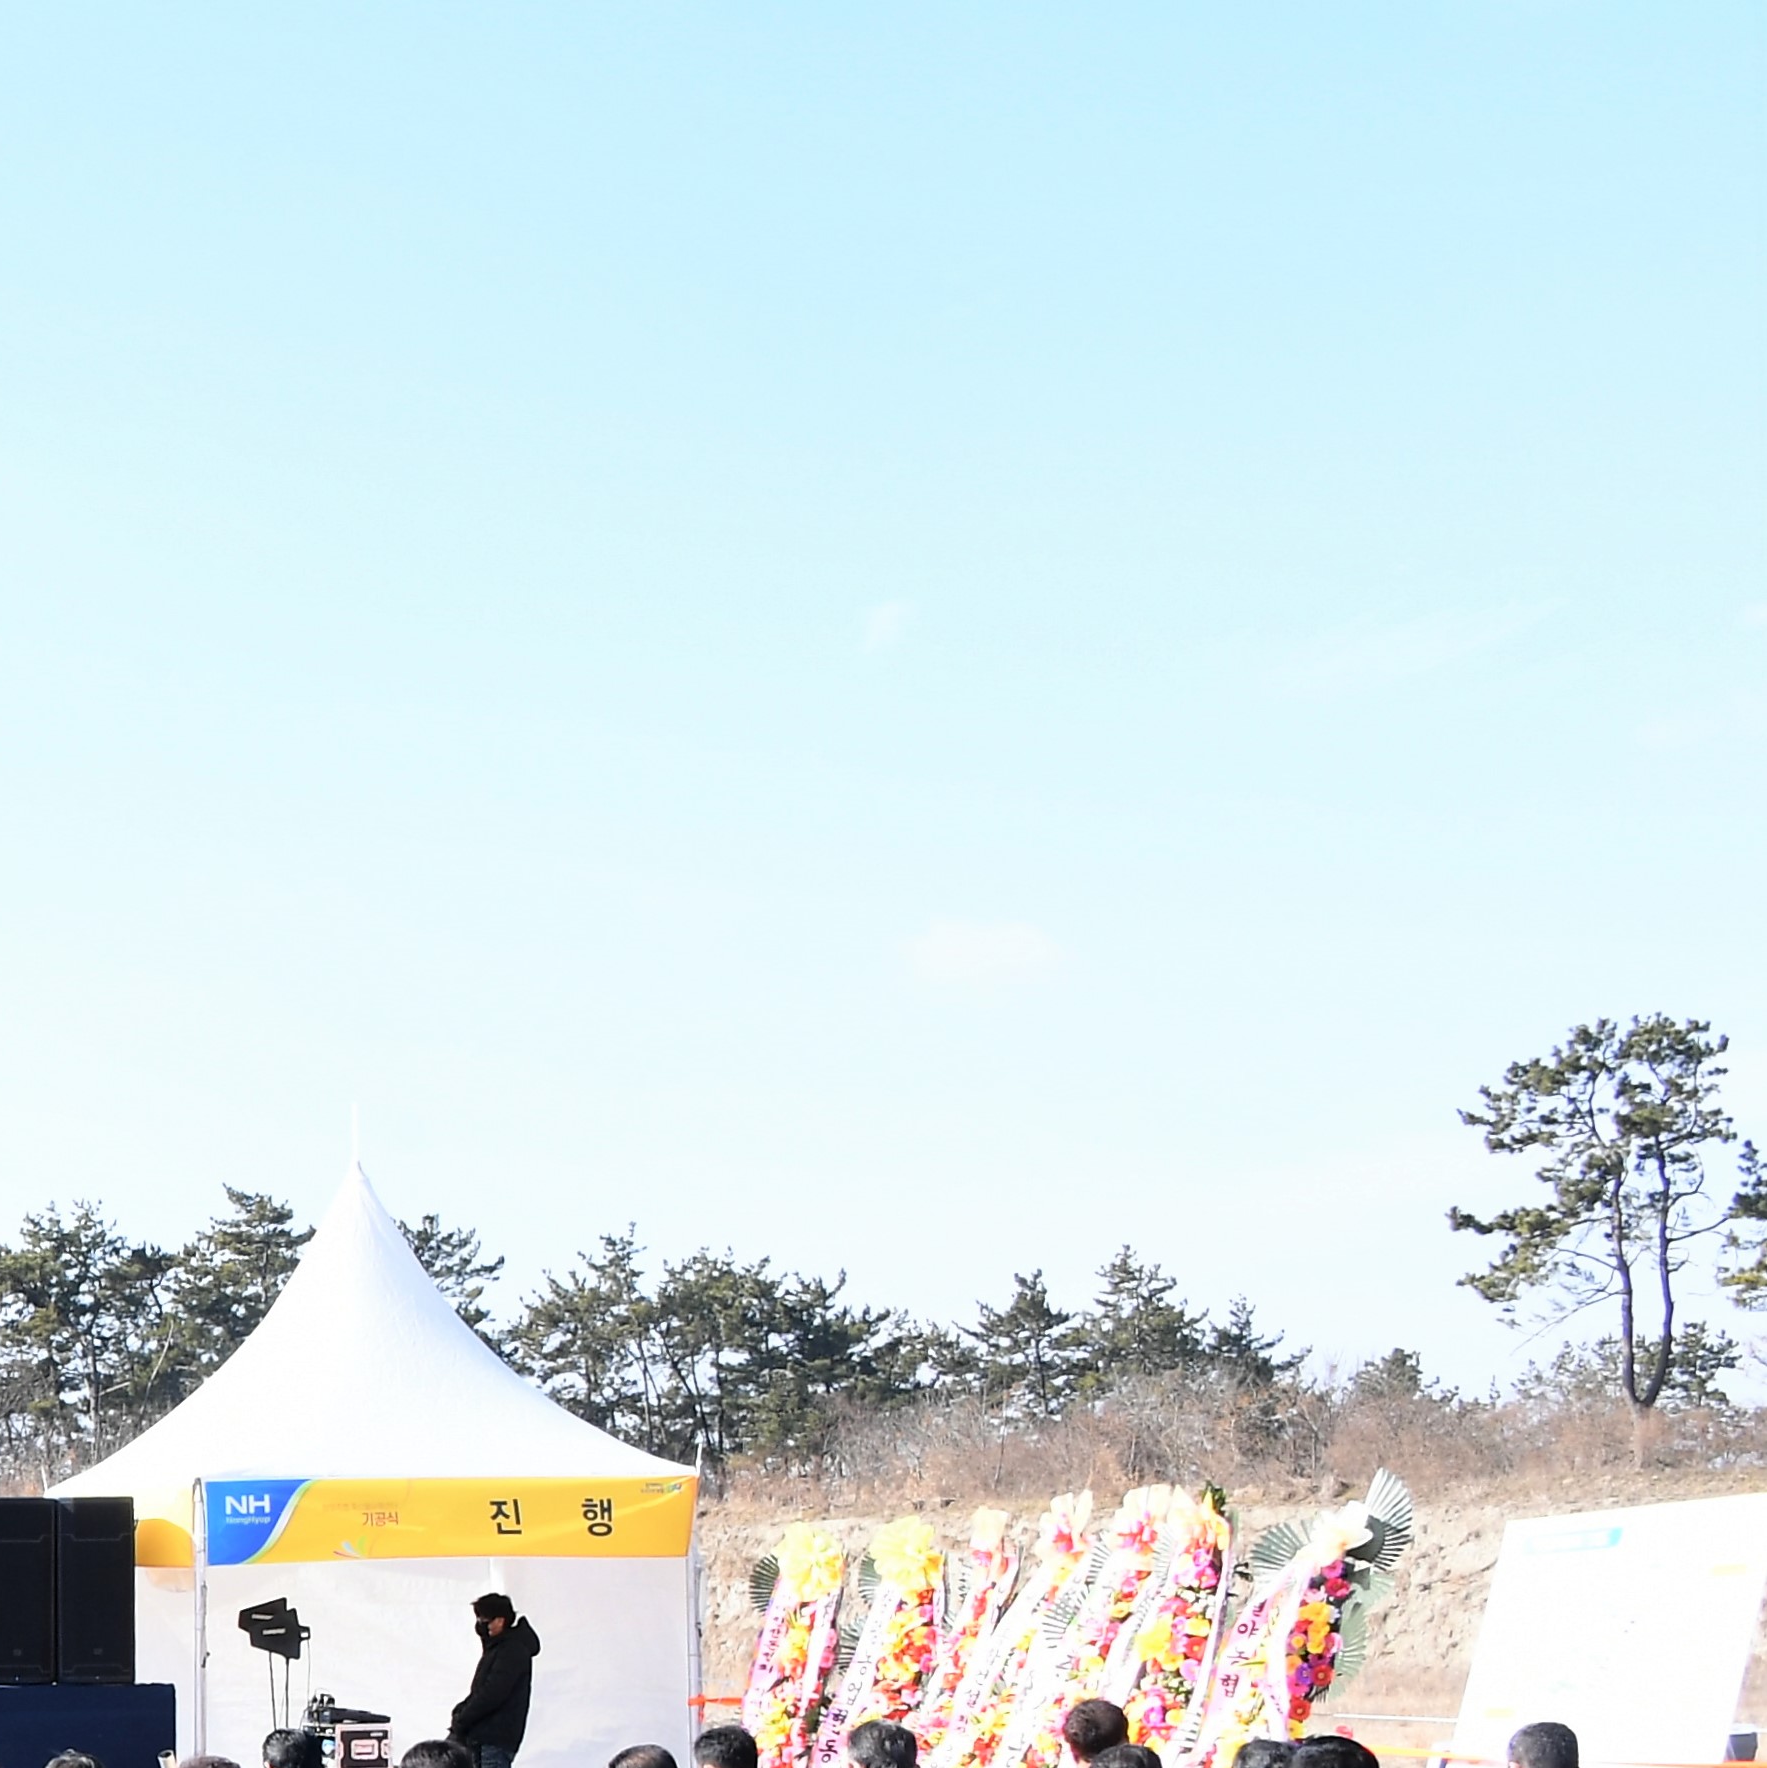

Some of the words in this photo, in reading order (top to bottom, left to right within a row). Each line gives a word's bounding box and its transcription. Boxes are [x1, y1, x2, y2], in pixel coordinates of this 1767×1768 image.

[225, 1493, 271, 1516] NH
[361, 1511, 399, 1527] 기공식
[489, 1498, 523, 1535] 진
[581, 1497, 613, 1537] 행
